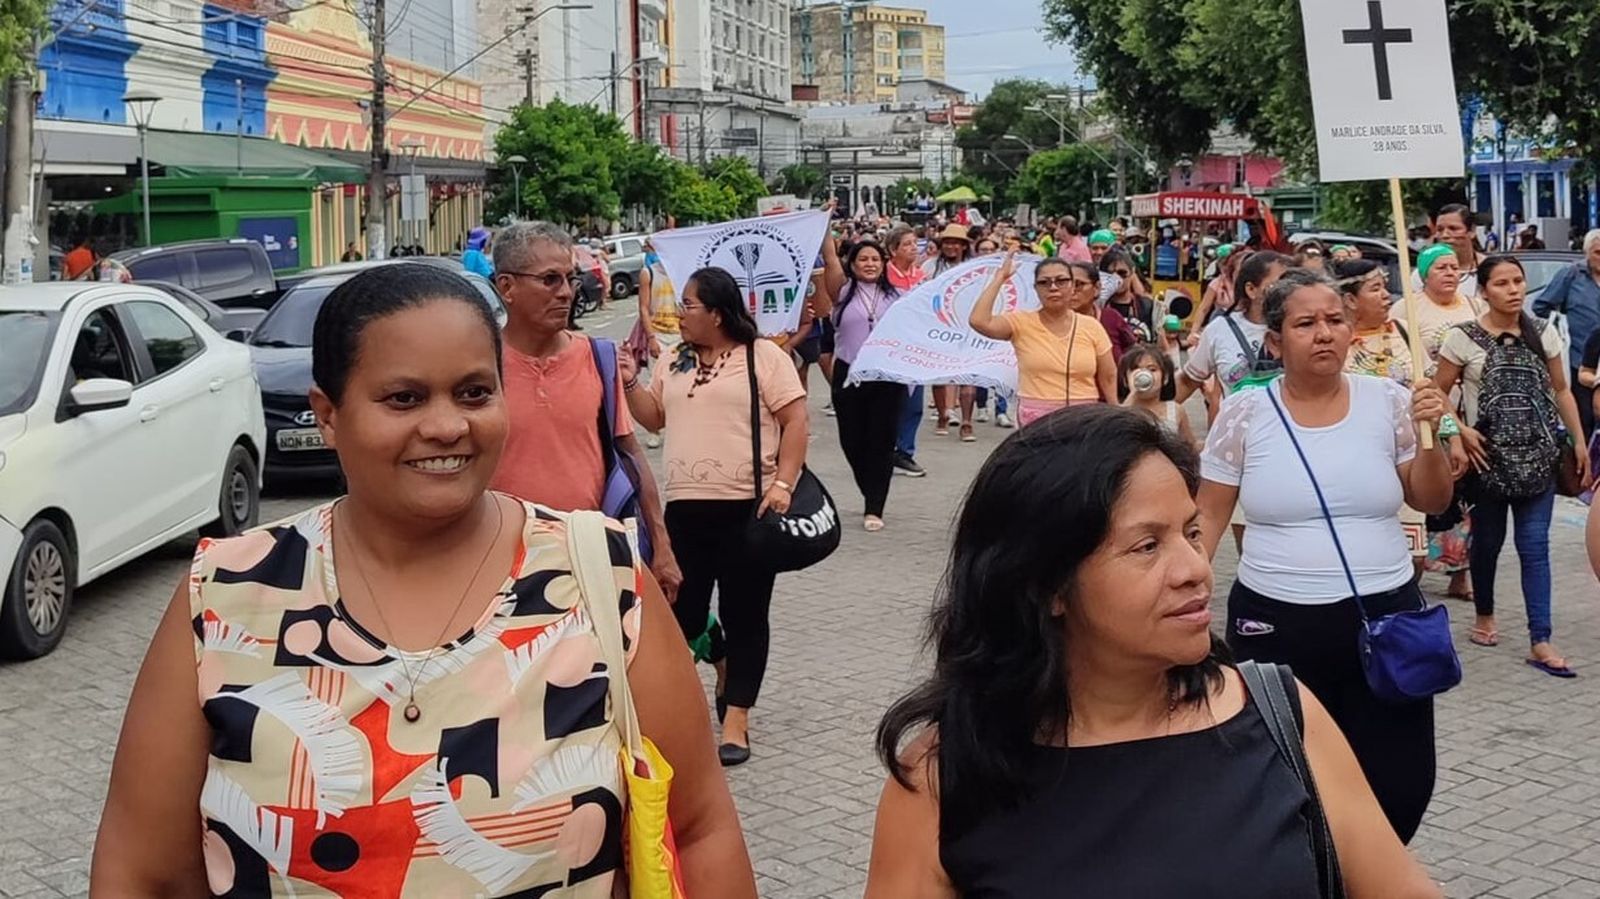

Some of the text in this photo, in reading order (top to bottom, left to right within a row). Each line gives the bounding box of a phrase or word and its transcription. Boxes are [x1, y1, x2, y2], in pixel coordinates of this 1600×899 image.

[1331, 126, 1367, 138] MARLICE
[1369, 124, 1408, 137] ANDRADE
[1409, 124, 1420, 135] DA
[1163, 197, 1244, 216] SHEKINAH
